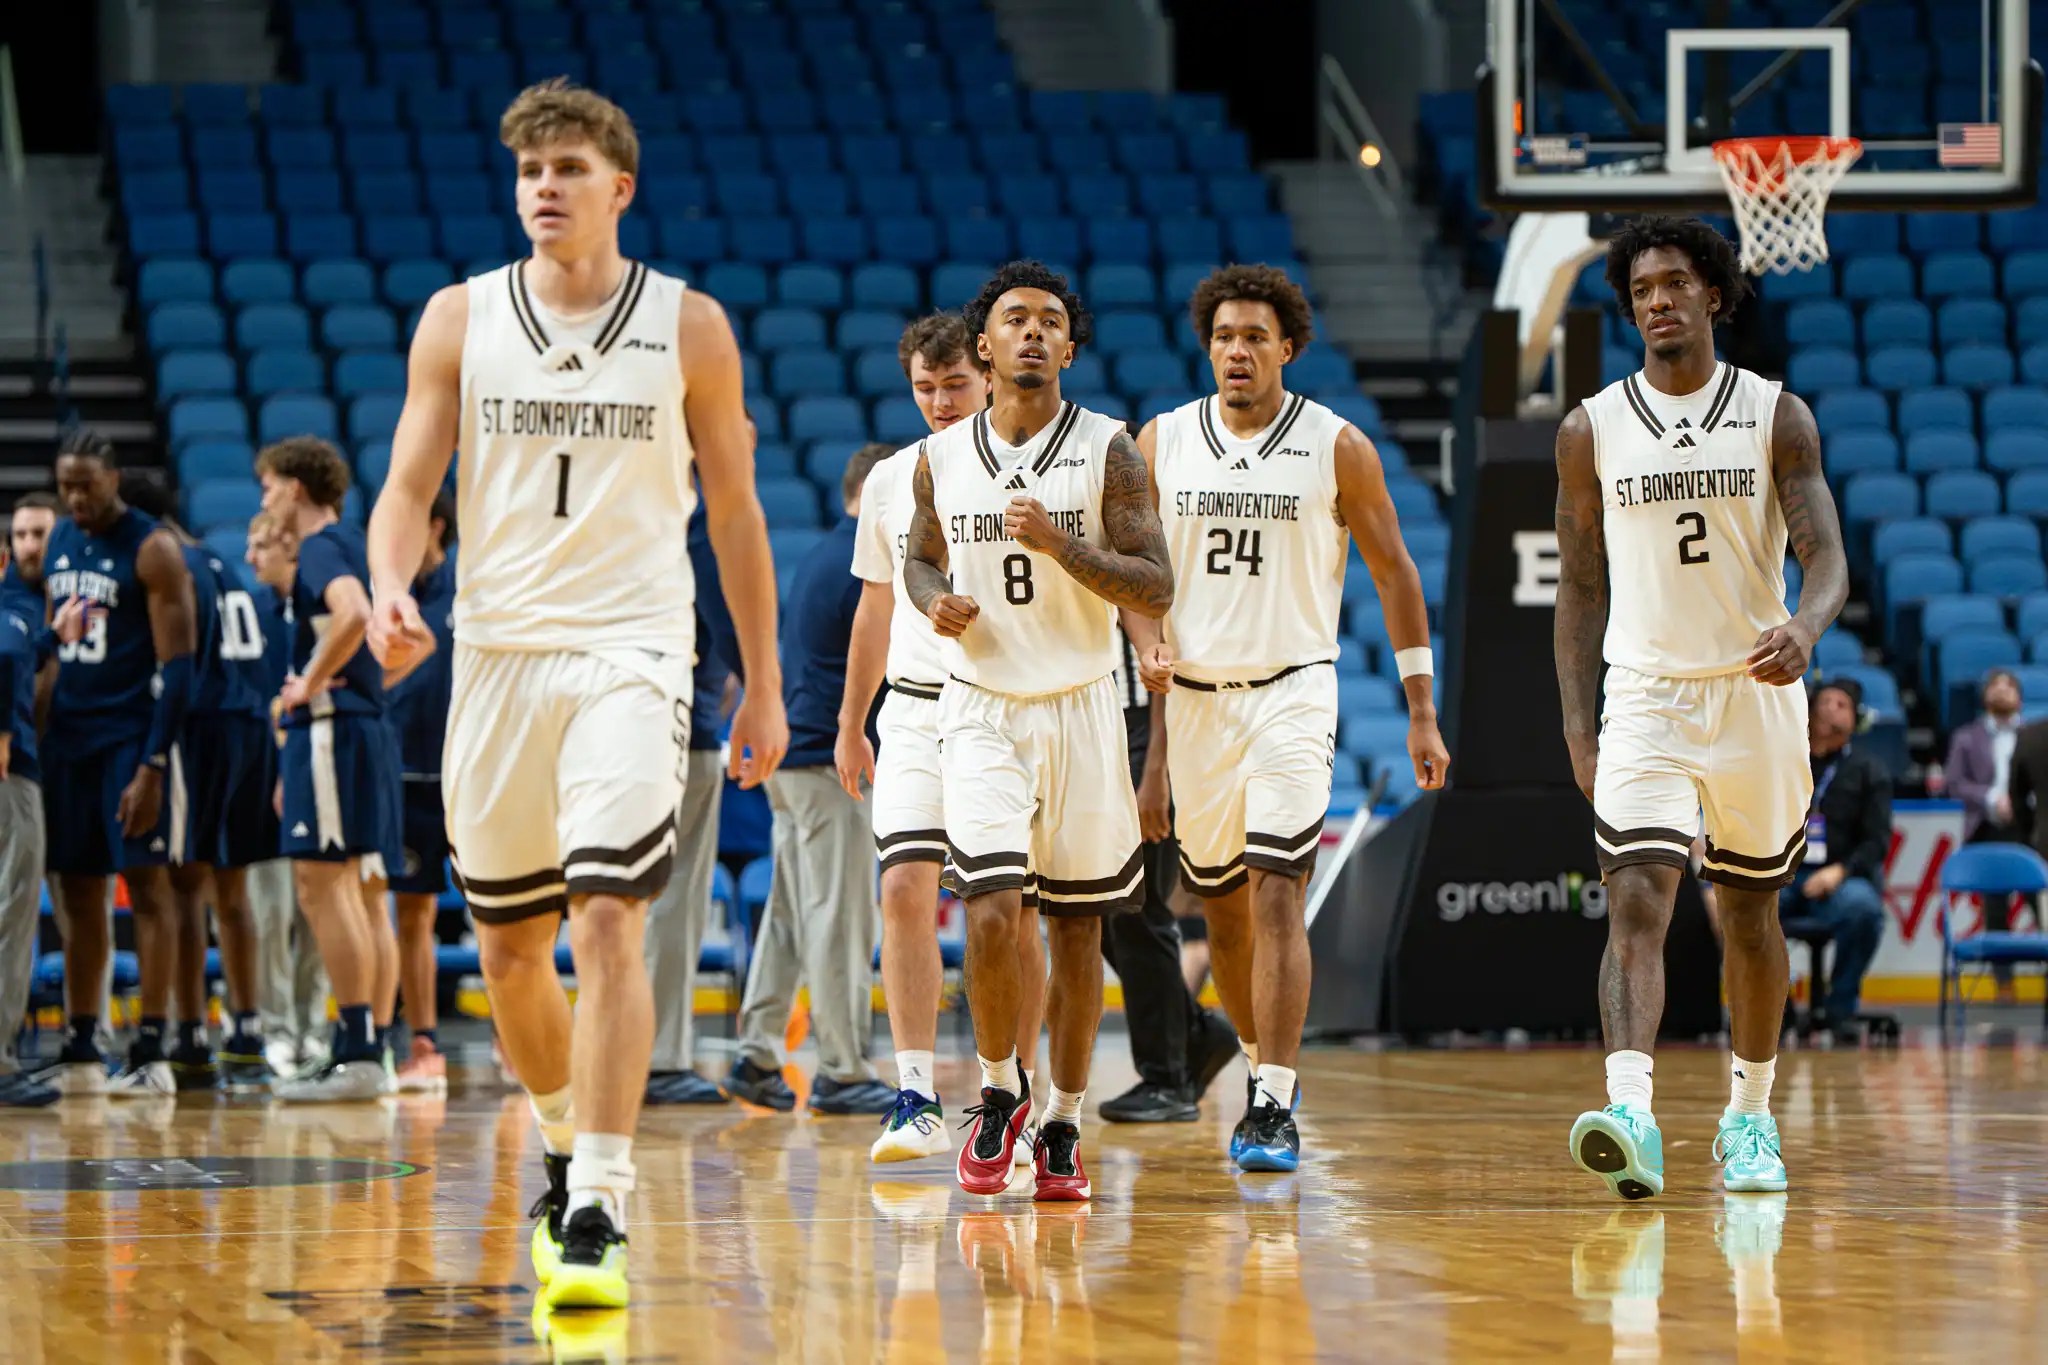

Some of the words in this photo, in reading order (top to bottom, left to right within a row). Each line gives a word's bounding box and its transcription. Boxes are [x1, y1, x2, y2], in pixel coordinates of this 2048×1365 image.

[482, 398, 507, 435] ST.
[513, 399, 656, 441] BONAVENTURE
[1277, 448, 1310, 457] A10
[553, 453, 571, 518] 1
[1176, 491, 1194, 517] ST.
[1197, 491, 1300, 521] BONAVENTURE
[1616, 478, 1639, 507] ST.
[1641, 468, 1756, 504] BONAVENTURE
[951, 514, 970, 544] ST.
[974, 509, 1085, 542] BONURE
[1676, 511, 1710, 565] 2
[1207, 528, 1263, 576] 24
[1003, 553, 1034, 606] 8
